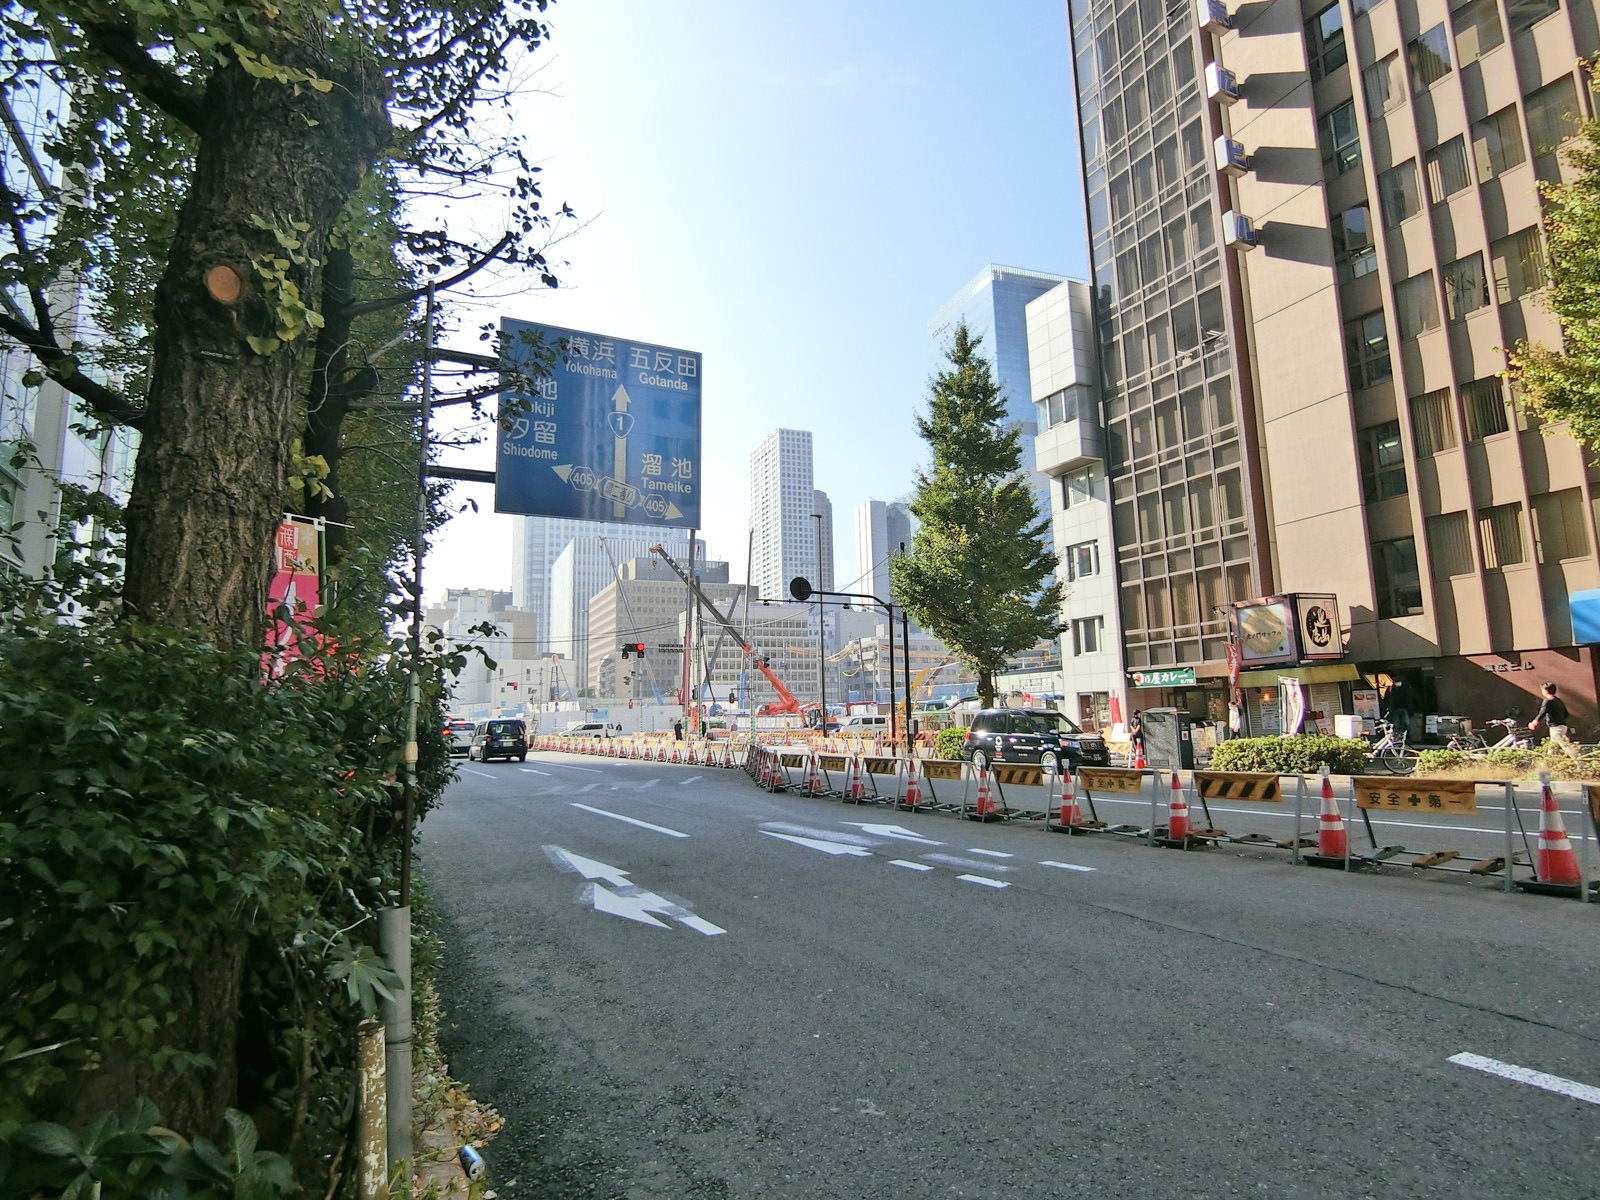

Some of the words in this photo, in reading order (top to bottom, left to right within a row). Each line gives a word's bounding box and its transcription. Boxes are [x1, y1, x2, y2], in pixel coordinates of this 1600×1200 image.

[567, 336, 615, 364] 横浜
[630, 346, 697, 378] 五反田
[565, 360, 617, 379] Yokohama
[639, 372, 689, 391] Gotanda
[505, 417, 557, 445] 汐留
[616, 416, 623, 430] 1
[503, 441, 558, 460] Shiodome
[641, 453, 692, 479] 溜池
[573, 472, 593, 485] 405
[641, 476, 692, 494] Tameike
[646, 500, 664, 512] 405
